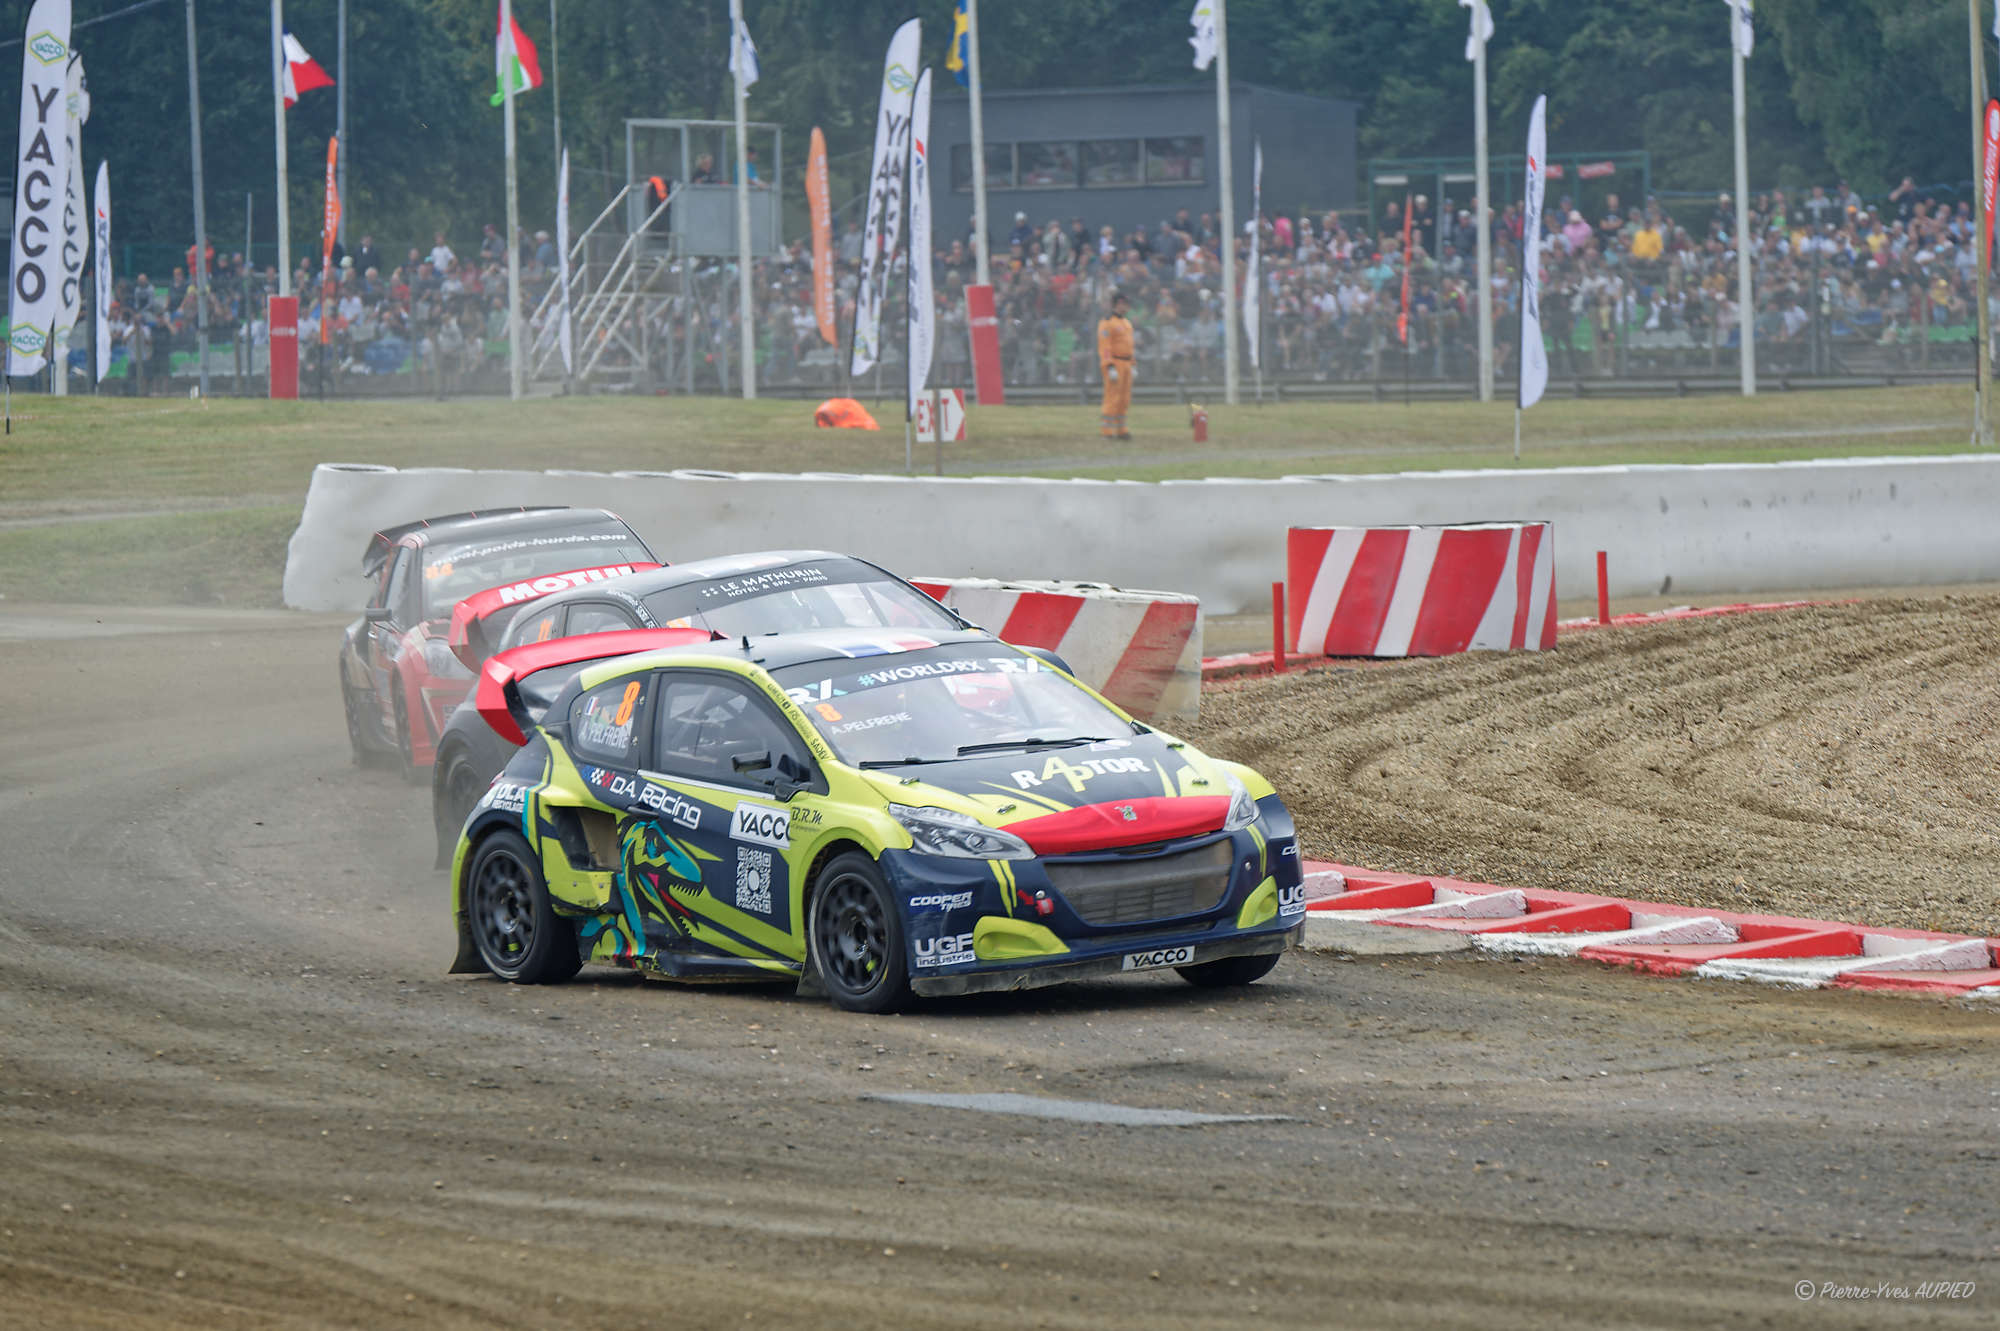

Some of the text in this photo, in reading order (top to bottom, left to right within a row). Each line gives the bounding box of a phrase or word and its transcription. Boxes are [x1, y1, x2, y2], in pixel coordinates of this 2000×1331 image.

[16, 84, 59, 303] YACCO
[917, 398, 949, 433] EXT
[719, 568, 822, 592] LE MATHURIN
[803, 575, 829, 583] PARIS
[857, 660, 986, 687] #WORLDRX
[616, 681, 640, 727] 8
[815, 703, 843, 722] 8
[1010, 756, 1151, 793] RAPTOR
[740, 810, 791, 842] YACC
[909, 891, 973, 907] COOPER
[915, 933, 974, 956] UGF
[1132, 948, 1188, 968] YACCO
